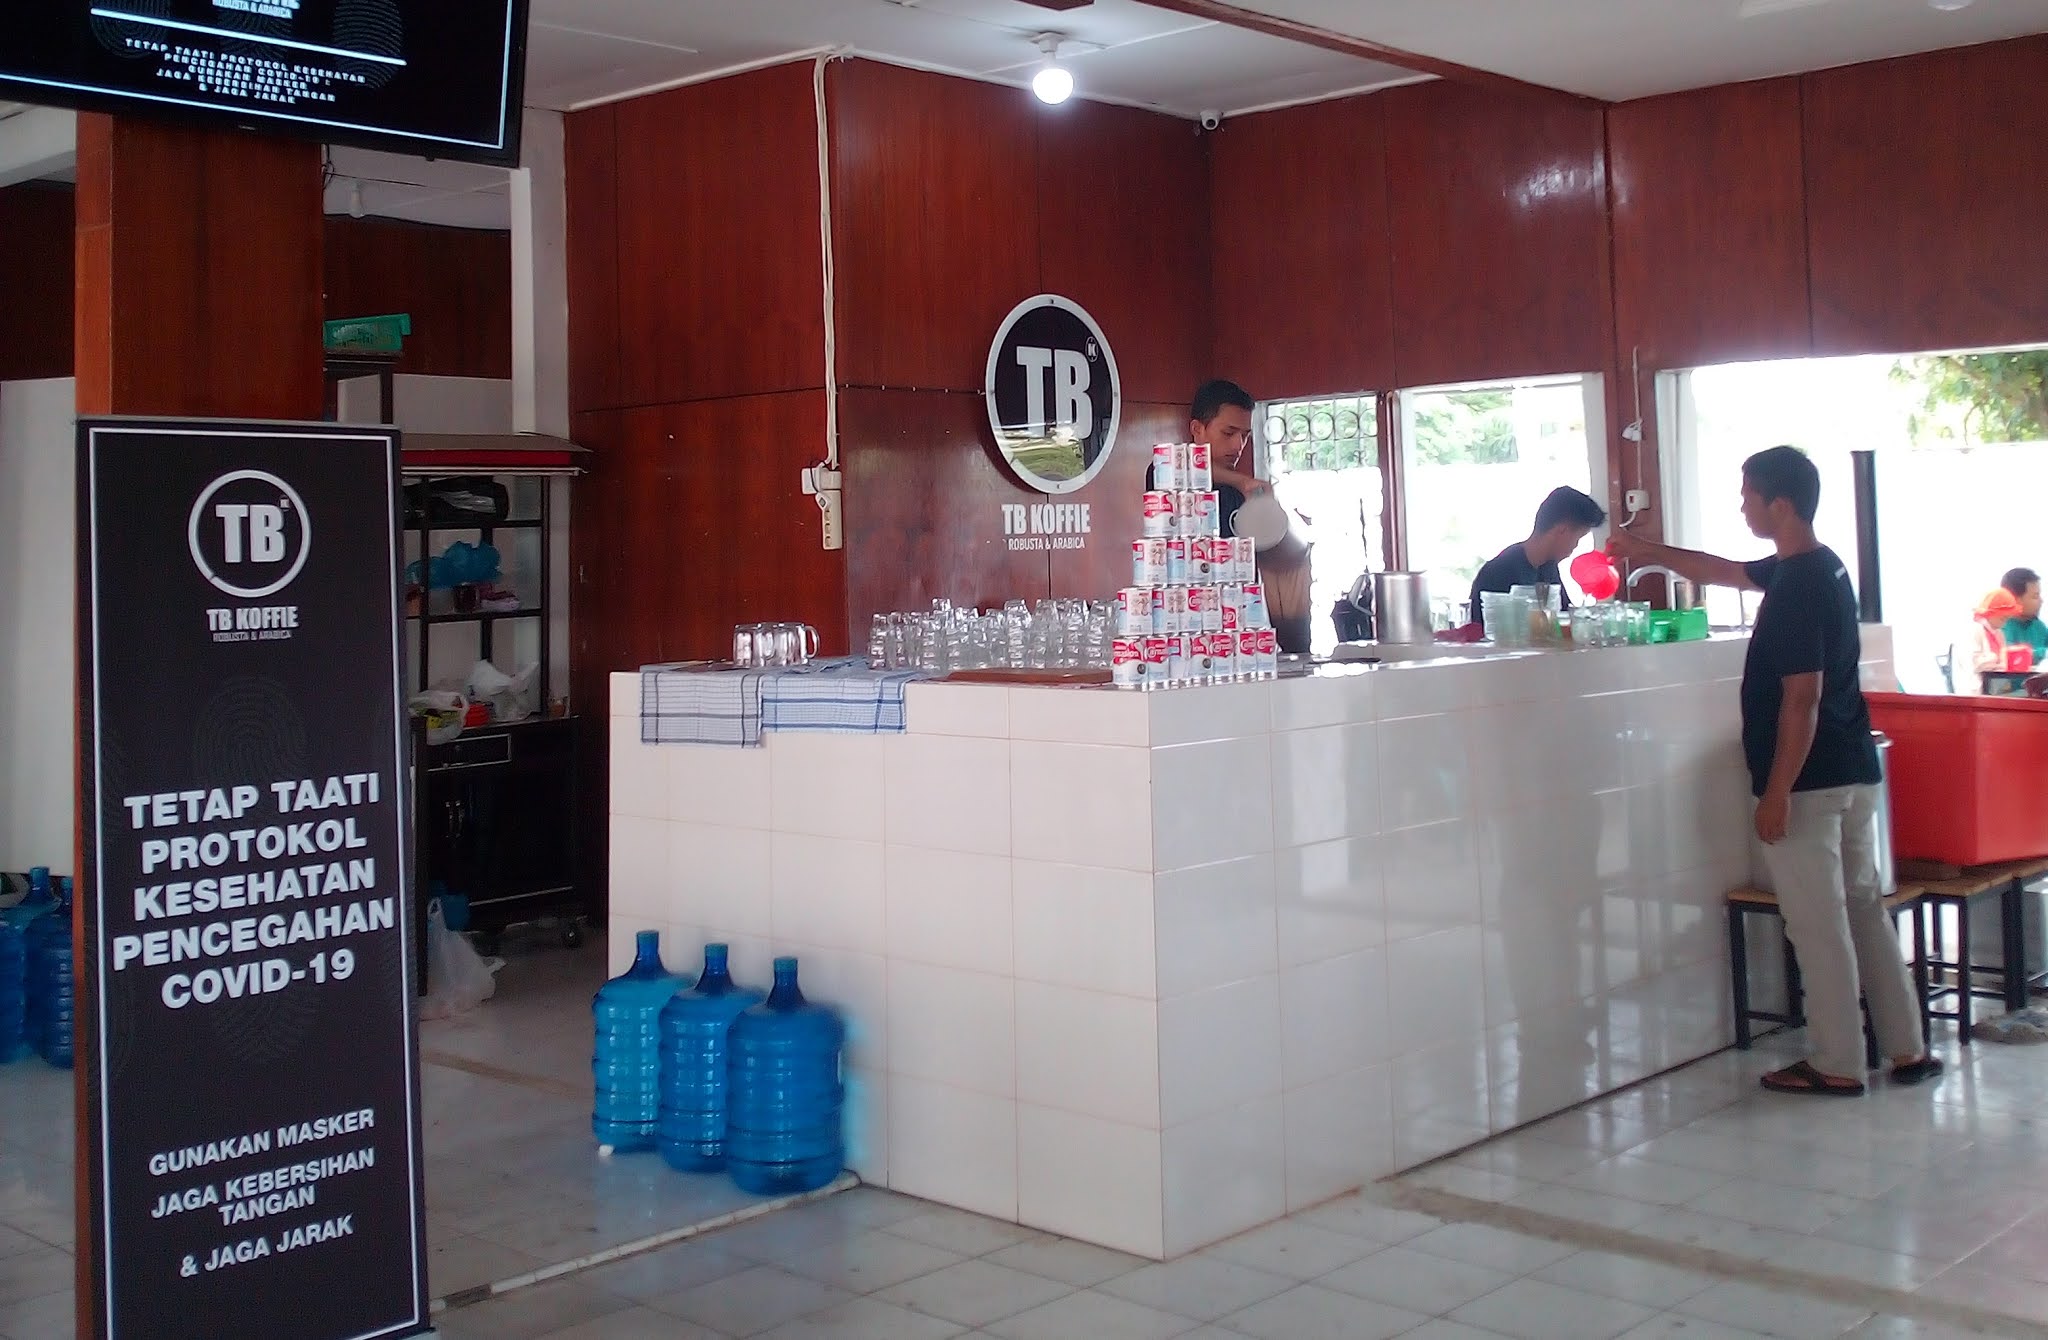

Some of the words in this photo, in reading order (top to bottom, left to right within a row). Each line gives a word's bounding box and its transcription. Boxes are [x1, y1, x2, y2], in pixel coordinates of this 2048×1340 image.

[125, 38, 169, 52] TETAP
[174, 46, 215, 60] TAATI
[221, 53, 288, 71] PROTOKOL
[293, 64, 366, 83] KESEHATAN
[156, 68, 191, 81] JAGA
[198, 74, 280, 94] KEBERSIHAN
[286, 88, 336, 102] TANGAN
[164, 53, 252, 73] PENCEGAHAN
[188, 65, 251, 81] GUNAKAN
[256, 75, 308, 90] MASKER
[214, 86, 248, 97] JAGA
[254, 92, 296, 104] JARAK
[1016, 345, 1094, 440] TB
[215, 504, 286, 563] TB
[1001, 503, 1027, 535] TB
[1030, 503, 1091, 535] KOFFIE
[1008, 538, 1044, 551] ROBUSTA
[1045, 537, 1052, 550] &
[1052, 537, 1085, 550] ARABICA
[206, 608, 233, 631] TB
[236, 606, 299, 630] KOFFIE
[123, 784, 260, 830] TETAP
[270, 772, 380, 814] TAATI
[142, 817, 368, 874] PROTOKOL
[134, 857, 376, 922] KESEHATAN
[112, 897, 395, 971] PENCEGAHAN
[161, 948, 356, 1010] COVID-19
[148, 1129, 271, 1177] GUNAKAN
[276, 1107, 376, 1150] MASKER
[151, 1183, 219, 1219] JAGA
[225, 1146, 376, 1202] KEBERSIHAN
[218, 1184, 316, 1227] TANGAN
[179, 1254, 198, 1279] &
[204, 1236, 271, 1273] JAGA
[276, 1212, 355, 1253] JARAK
